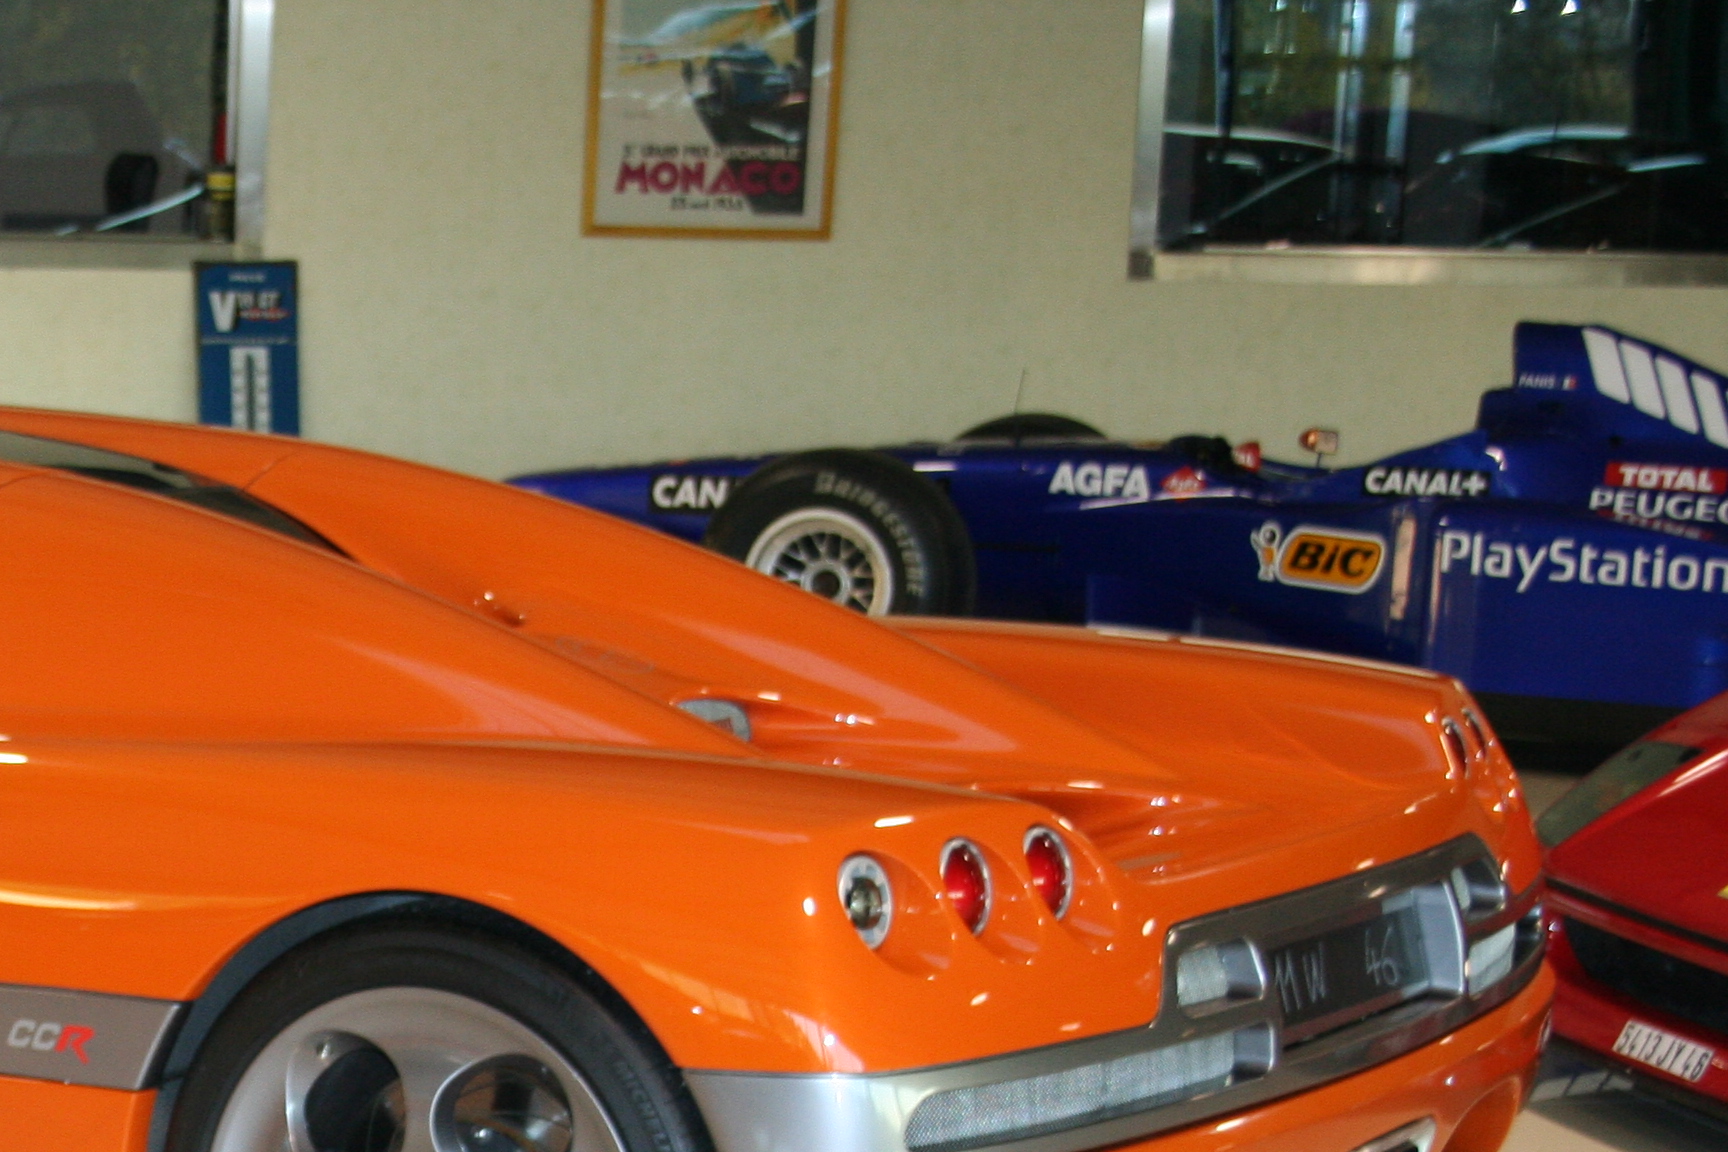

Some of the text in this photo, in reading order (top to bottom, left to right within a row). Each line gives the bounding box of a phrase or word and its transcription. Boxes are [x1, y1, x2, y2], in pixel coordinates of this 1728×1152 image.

[614, 160, 802, 196] MONACO
[651, 474, 736, 510] CAN
[1048, 460, 1150, 502] AGFA
[1364, 466, 1486, 497] CANAL+
[1619, 463, 1714, 493] TOTAL
[1440, 530, 1728, 593] PlayStation
[6, 1018, 96, 1065] CCR
